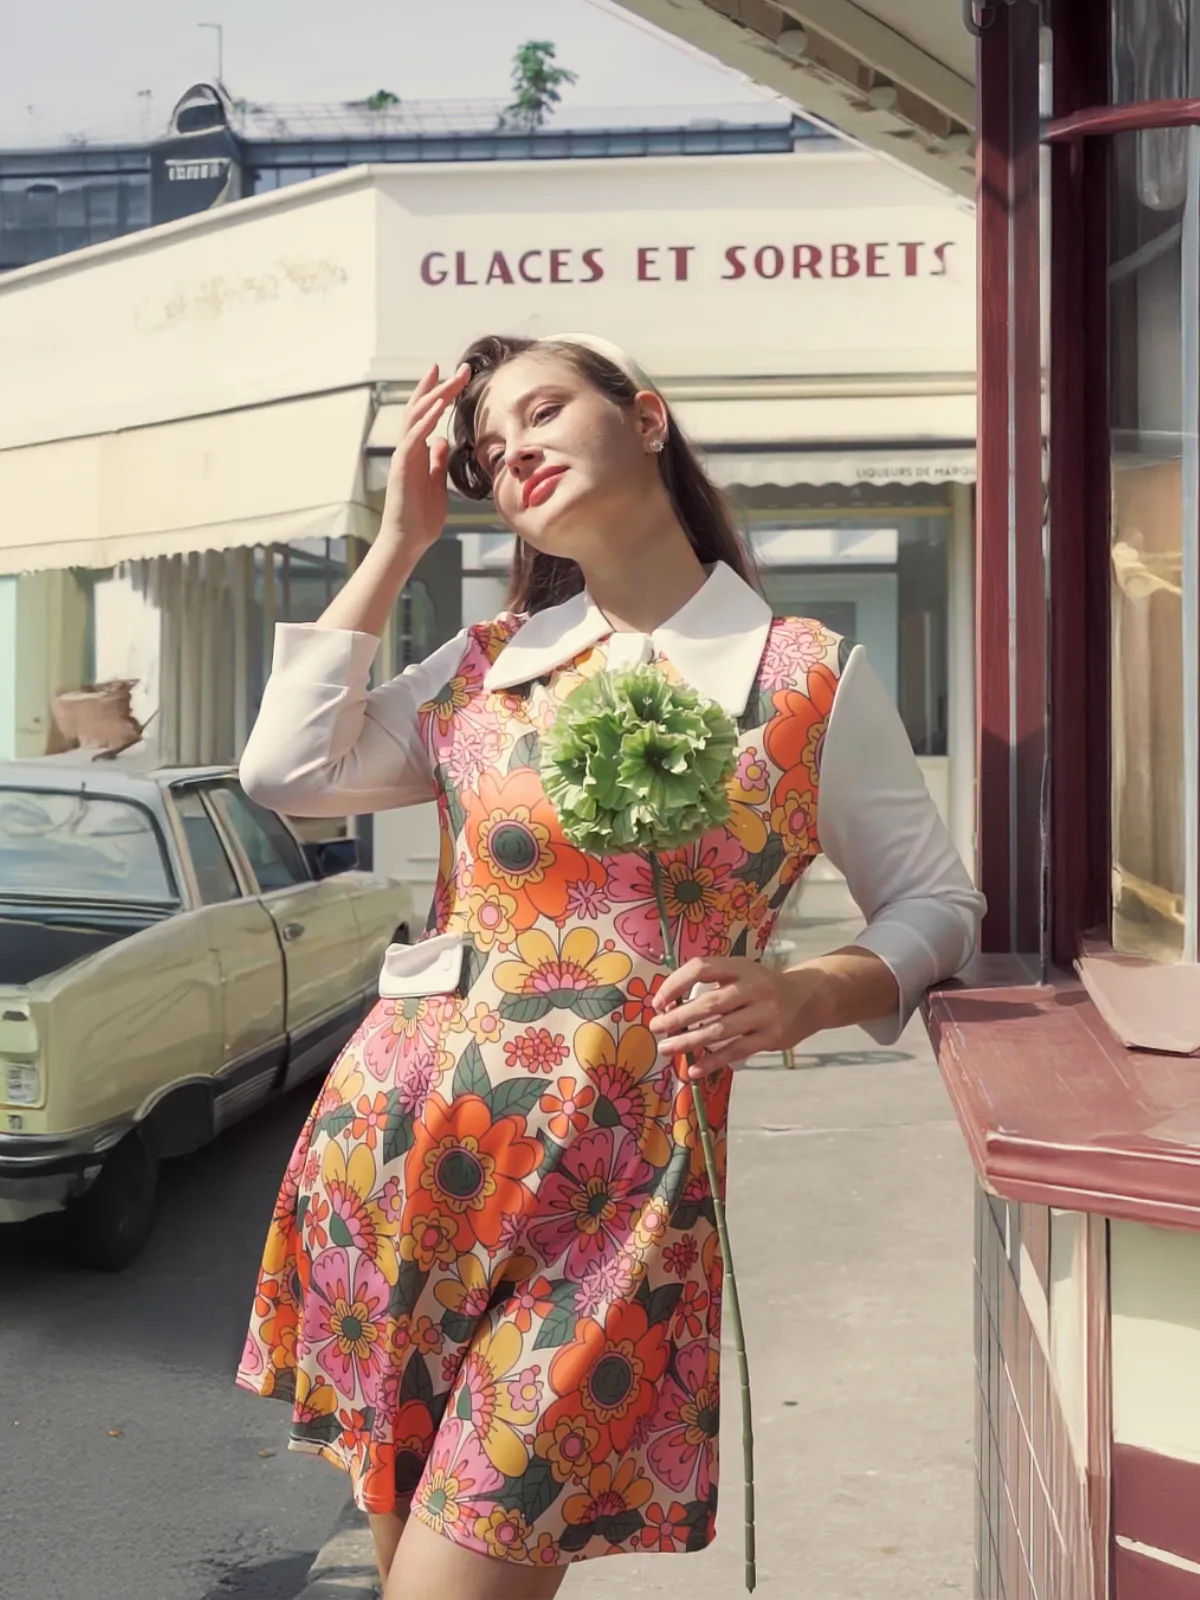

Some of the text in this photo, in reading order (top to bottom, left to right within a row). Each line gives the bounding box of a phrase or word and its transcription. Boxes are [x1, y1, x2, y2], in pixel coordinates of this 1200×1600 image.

[420, 241, 956, 286] GLACES ET SORBETS
[856, 467, 913, 479] LIQUEURS
[915, 466, 930, 477] DE
